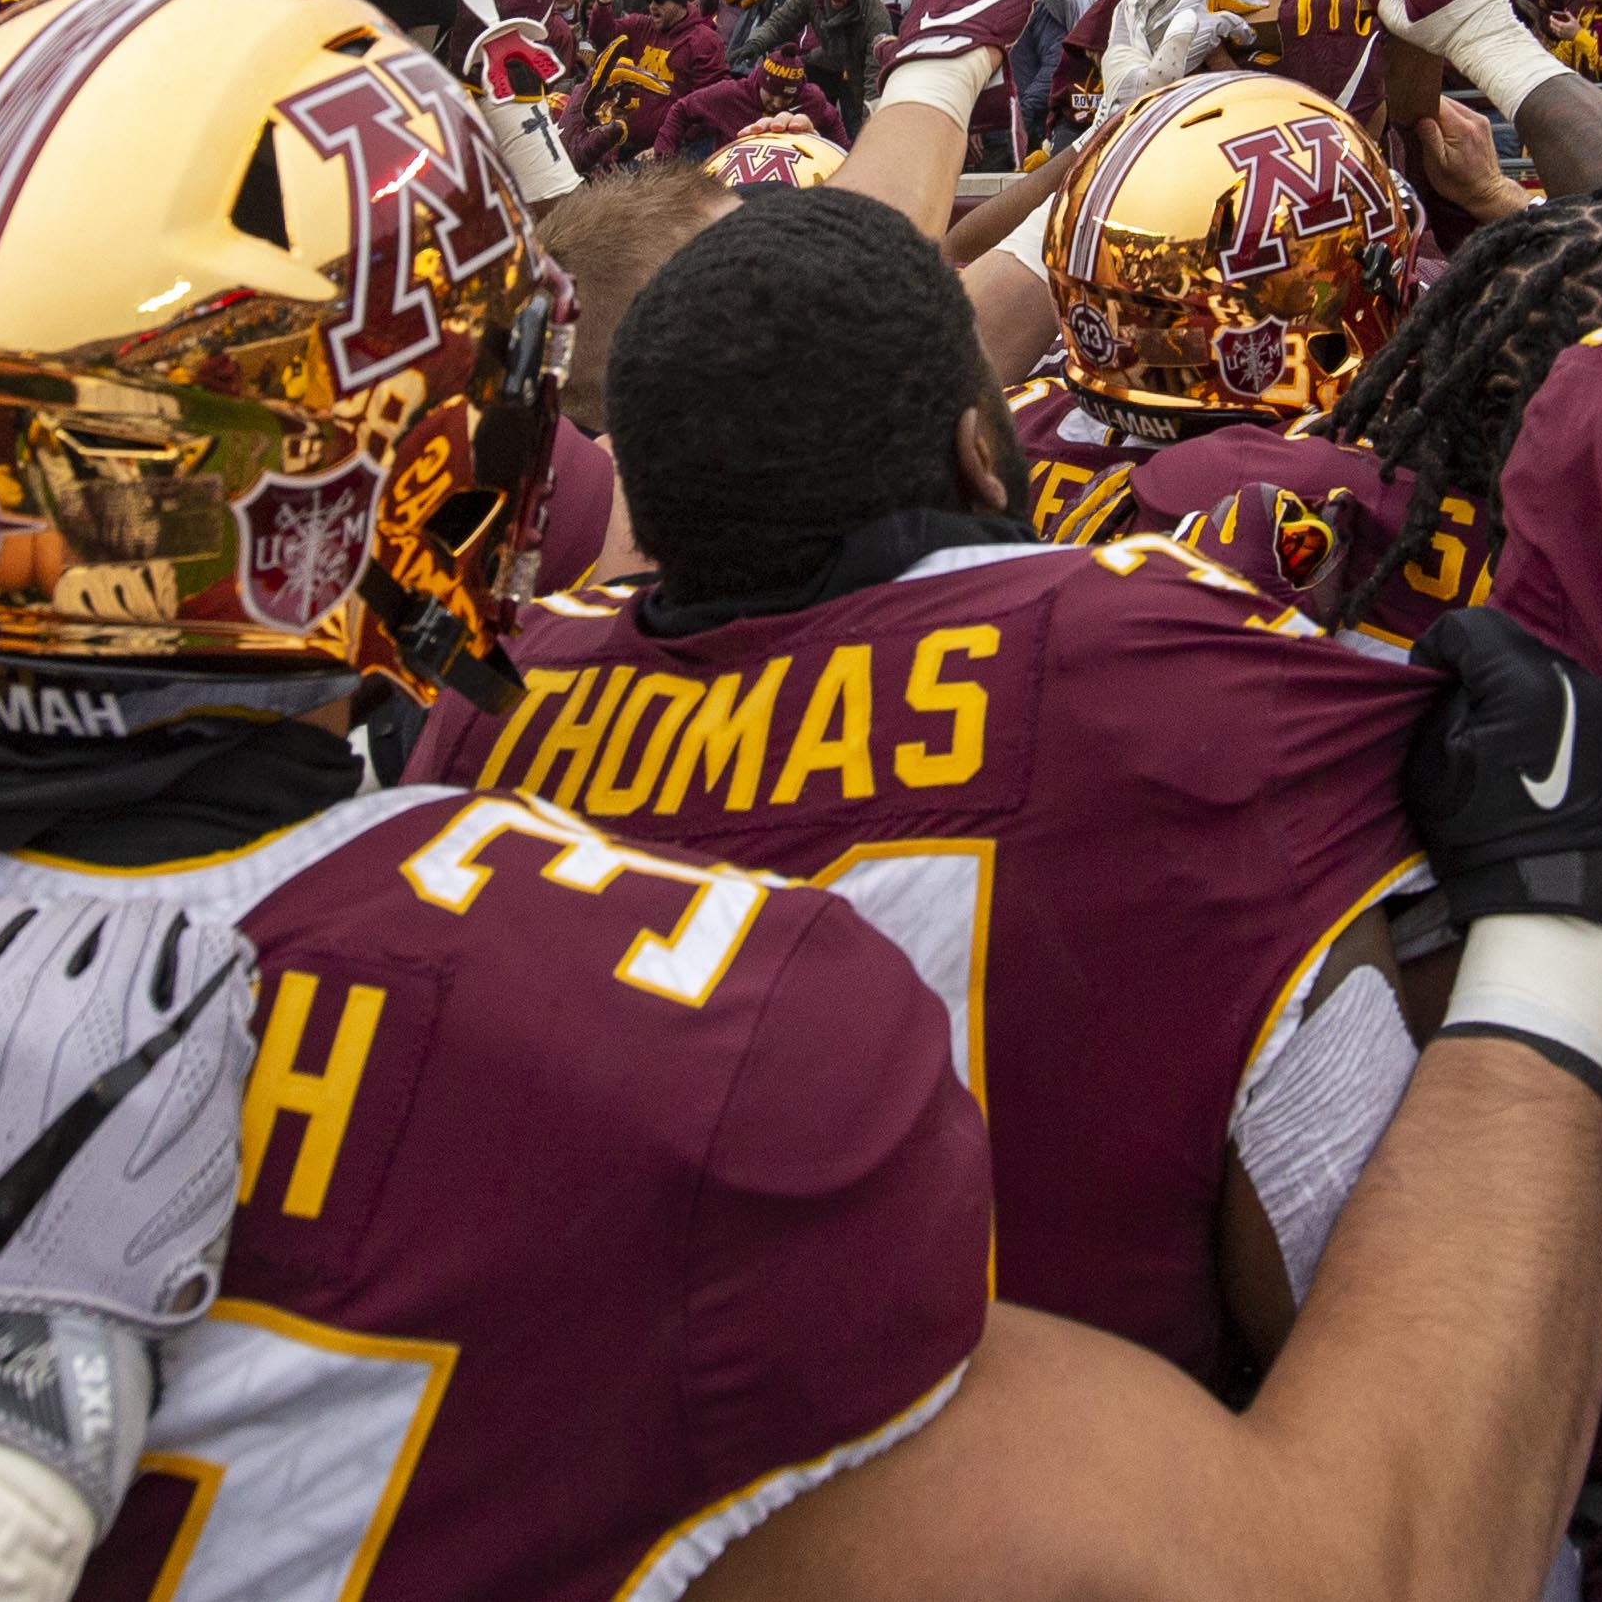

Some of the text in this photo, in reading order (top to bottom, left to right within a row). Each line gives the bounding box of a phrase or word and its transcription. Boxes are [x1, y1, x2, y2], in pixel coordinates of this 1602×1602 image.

[1075, 317, 1104, 351] 33
[476, 624, 1001, 817] THOMAS
[71, 1352, 112, 1450] 3XL
